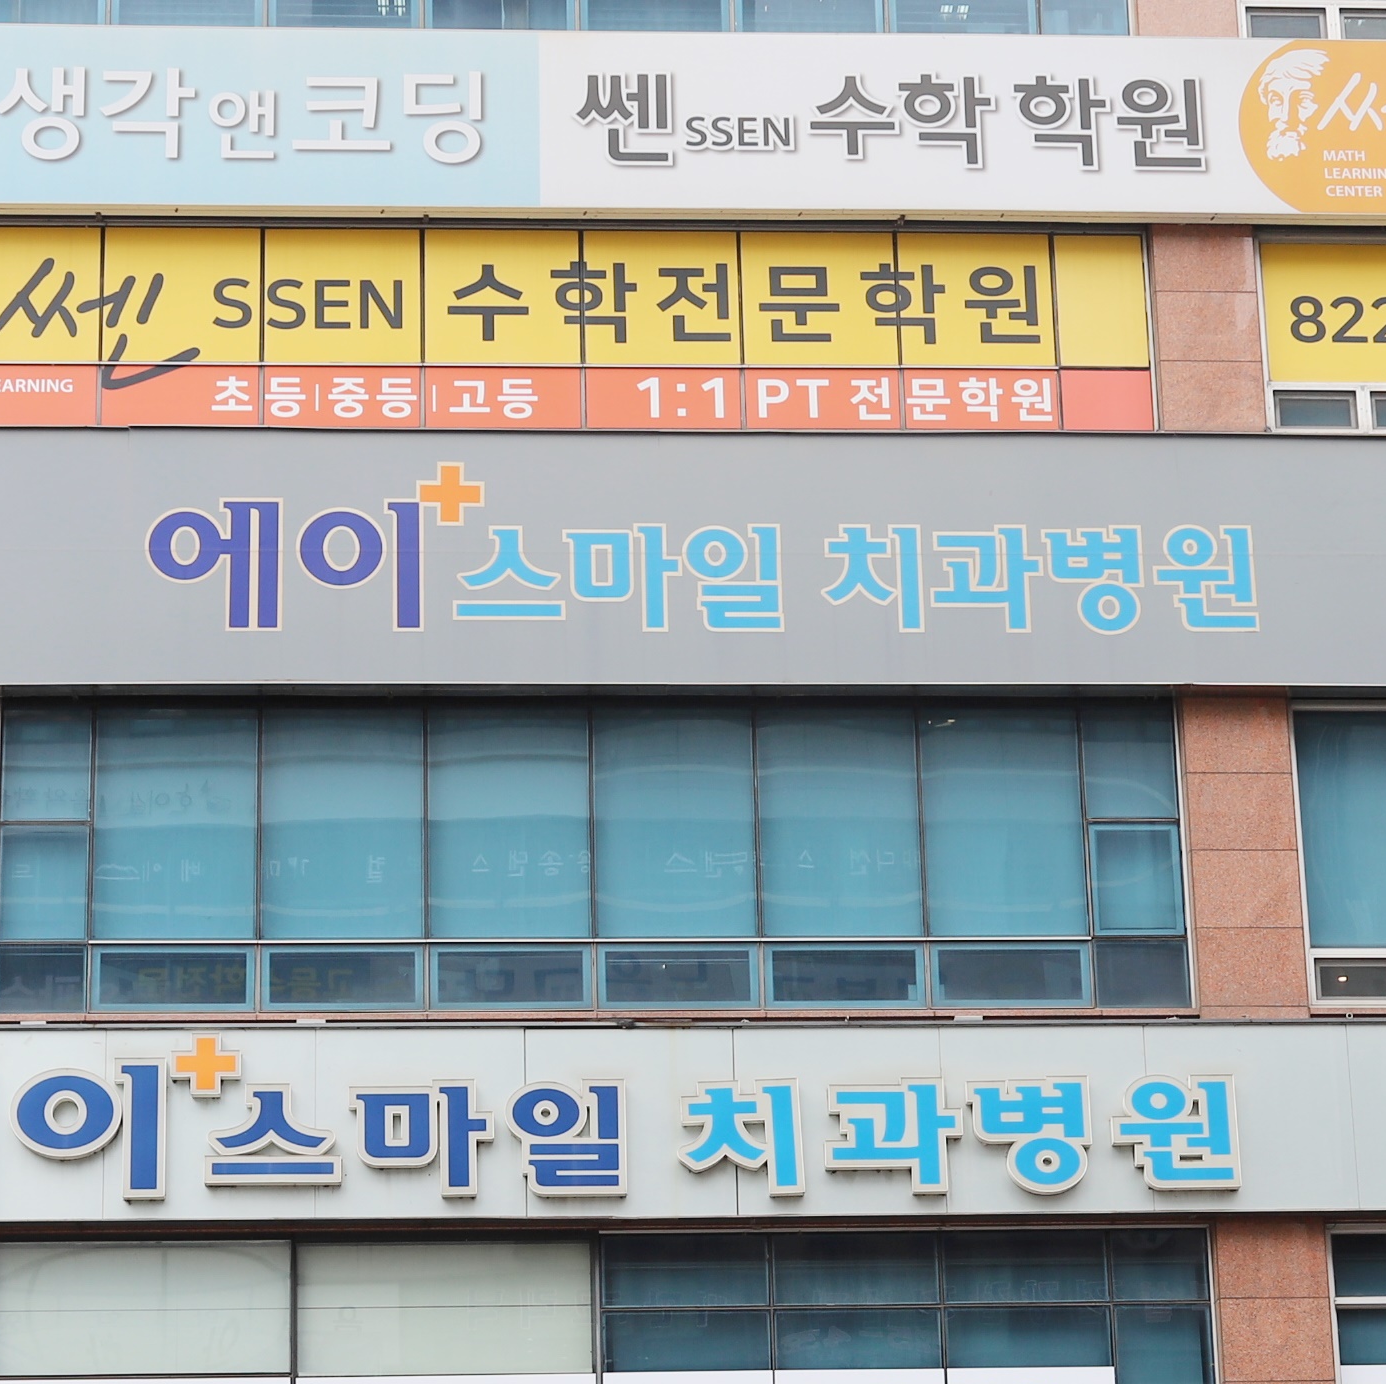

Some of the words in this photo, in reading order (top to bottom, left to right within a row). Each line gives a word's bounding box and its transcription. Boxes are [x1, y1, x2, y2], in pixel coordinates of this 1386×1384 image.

[575, 70, 676, 168] 쎈
[685, 114, 796, 152] SSEN
[1322, 149, 1366, 162] MATH
[1325, 184, 1383, 198] CENTER
[213, 279, 404, 330] SSEN
[636, 376, 729, 418] 1:1
[757, 379, 821, 419] PT
[850, 376, 1055, 425] 전문학원
[820, 521, 1261, 636] 치과병원
[678, 1070, 1245, 1198] 치과병원
